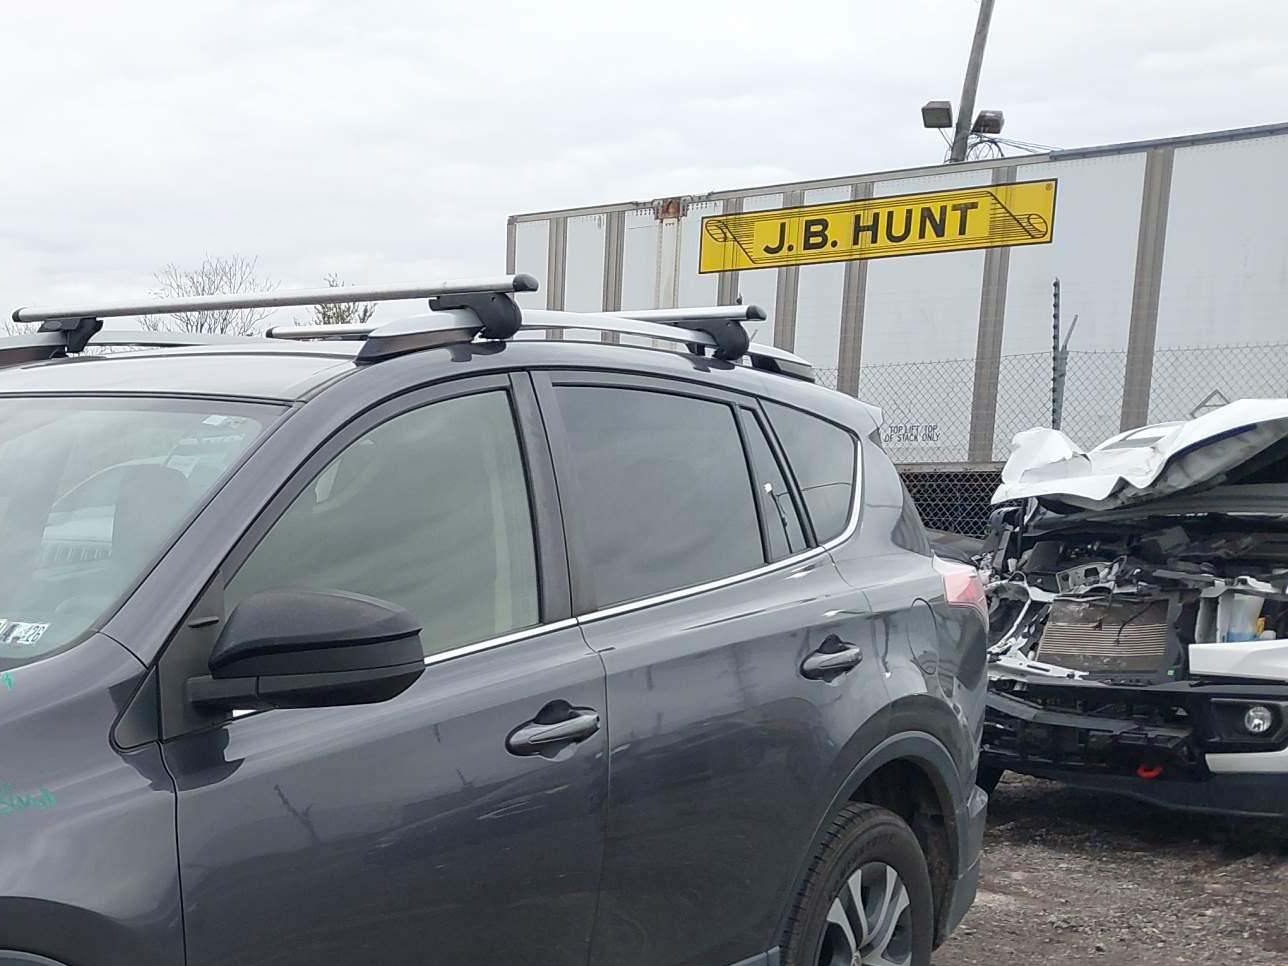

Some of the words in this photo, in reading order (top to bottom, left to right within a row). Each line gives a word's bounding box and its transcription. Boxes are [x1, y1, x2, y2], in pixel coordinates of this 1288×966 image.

[762, 217, 838, 255] J.B.
[852, 201, 980, 247] HUNT
[889, 425, 903, 434] TOP
[884, 434, 893, 442] OF
[897, 433, 919, 442] STACK
[922, 432, 940, 441] ONLY
